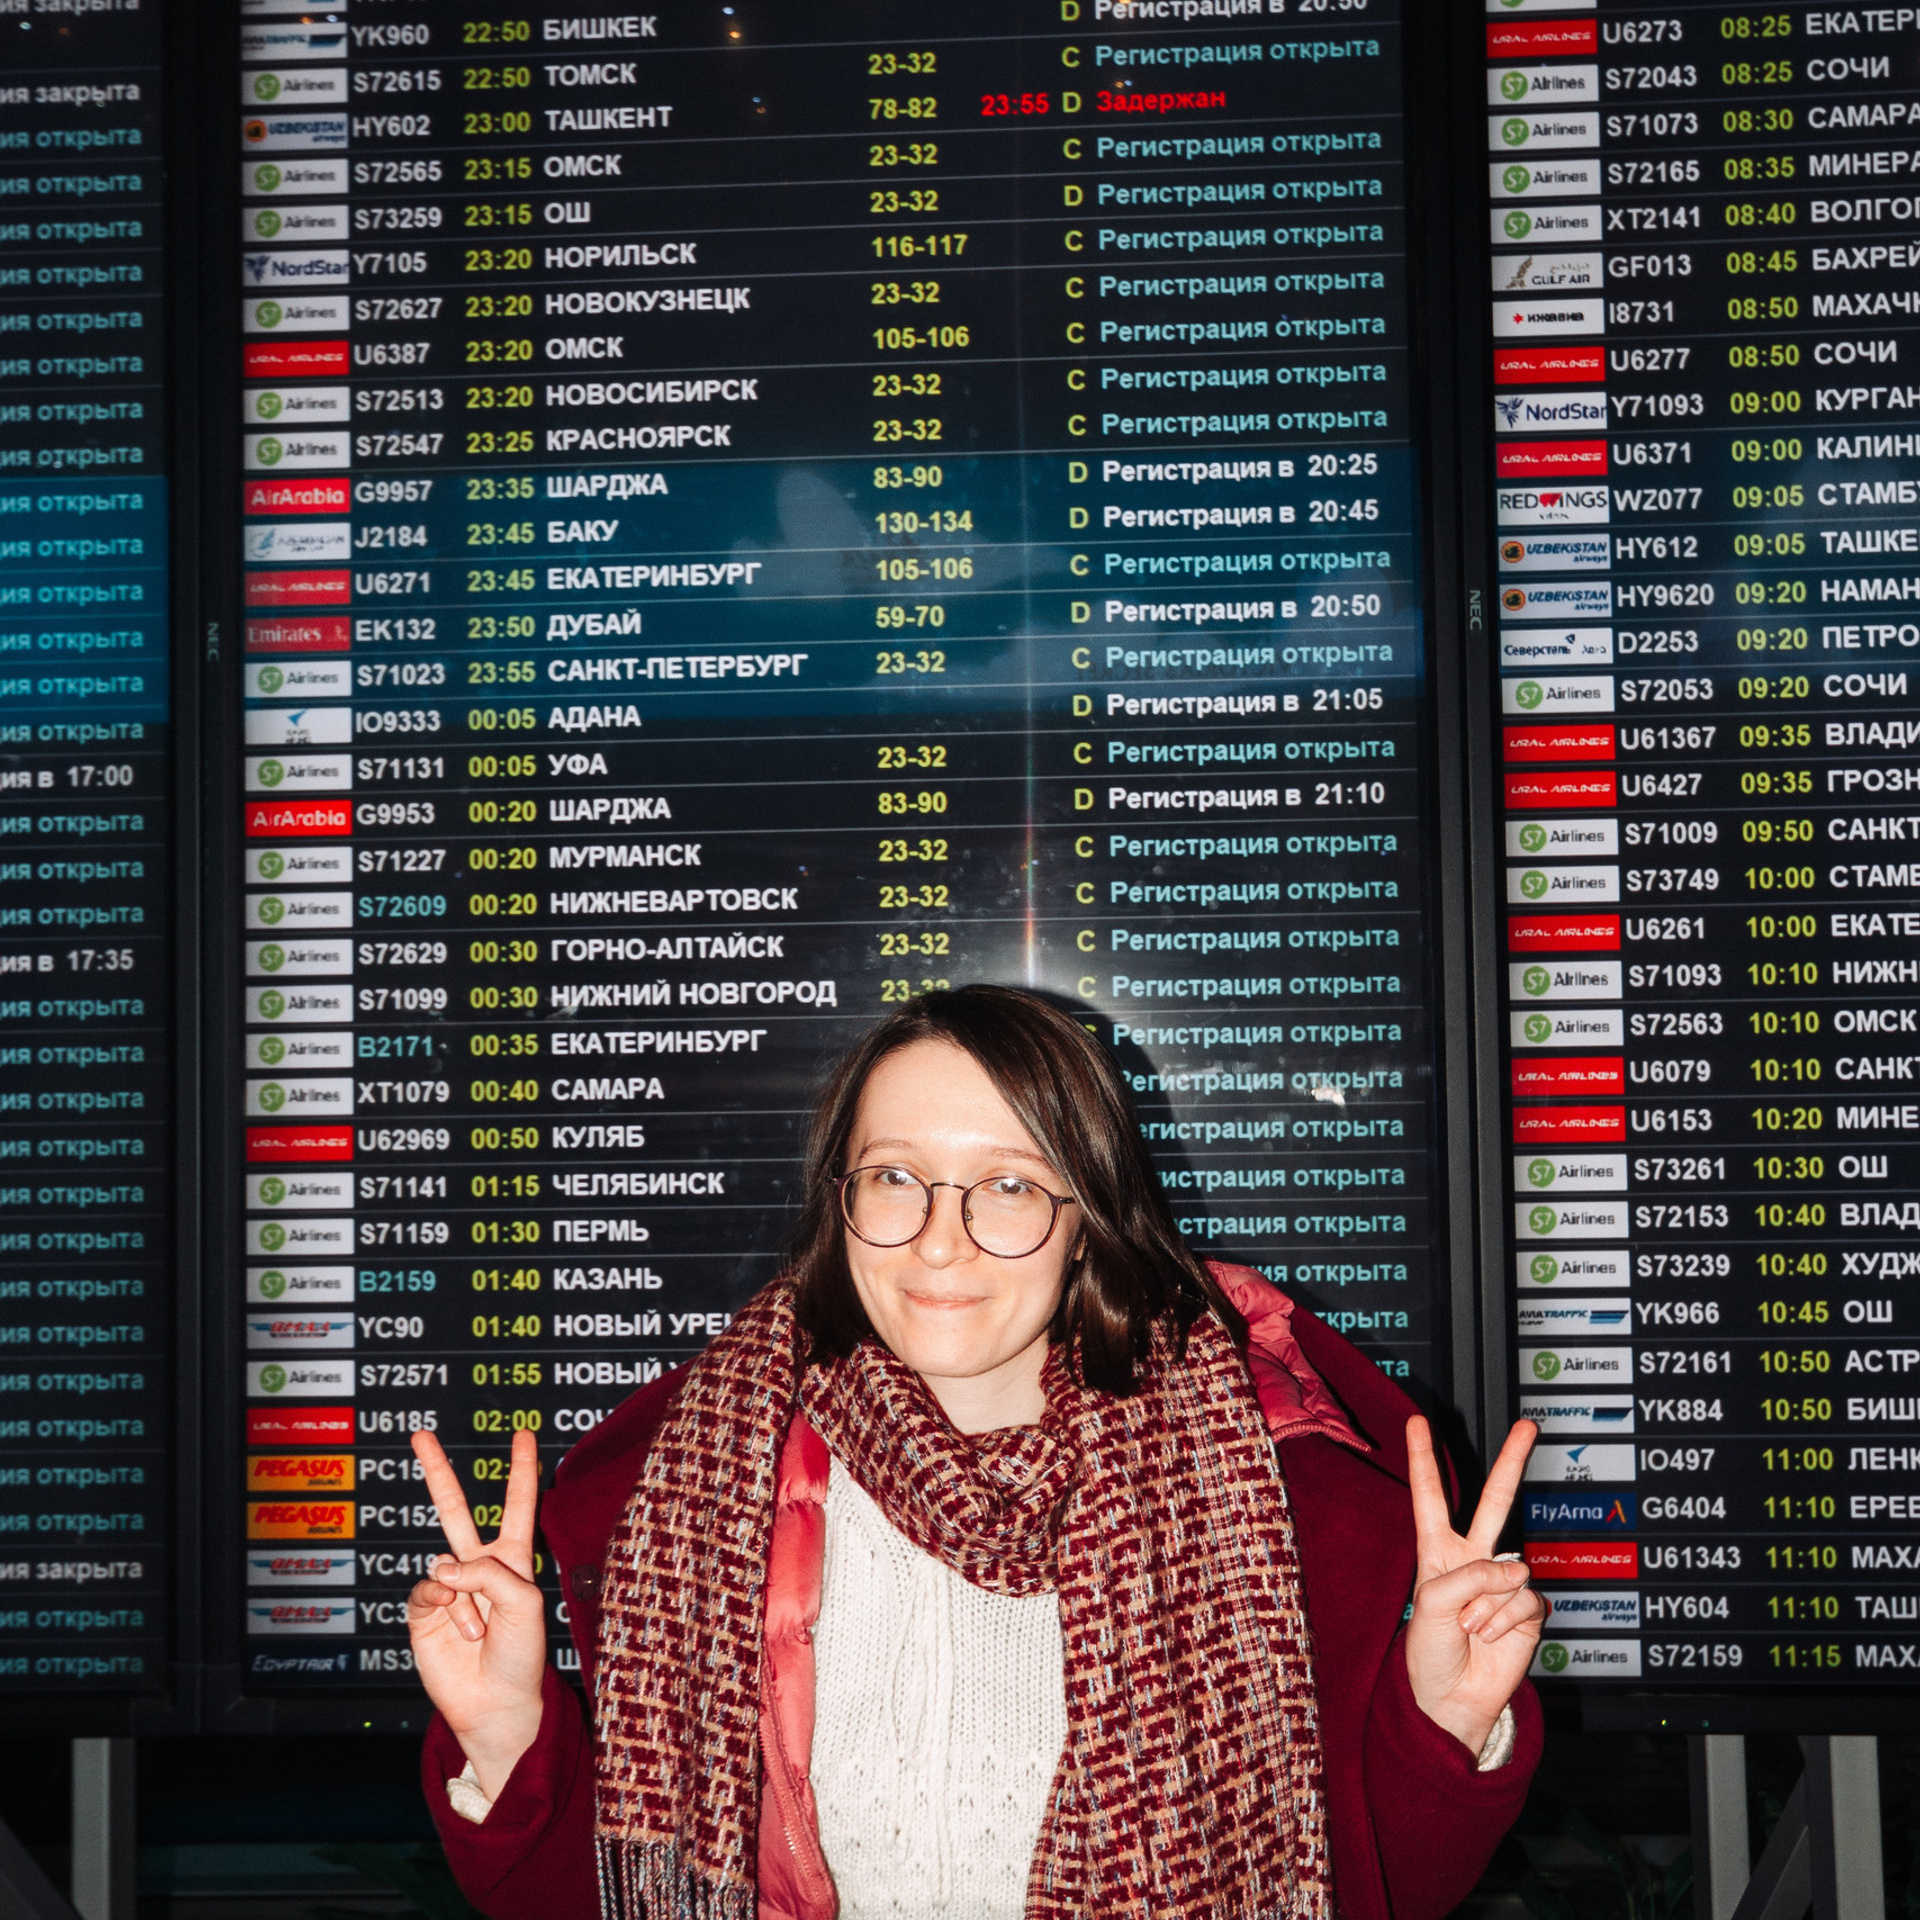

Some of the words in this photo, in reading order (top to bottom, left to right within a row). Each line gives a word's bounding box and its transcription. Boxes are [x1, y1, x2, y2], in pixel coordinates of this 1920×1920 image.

[1603, 20, 1682, 43] U6273
[1721, 15, 1791, 38] 08:25
[1806, 8, 1920, 35] ЕКАТЕР
[354, 70, 441, 92] S72615
[464, 67, 529, 89] 22:50
[544, 63, 636, 86] ТОМСК
[869, 52, 936, 74] 23-32
[1062, 47, 1079, 67] C
[1096, 45, 1262, 67] Регистрация
[1270, 40, 1379, 62] открыта
[1606, 65, 1697, 89] S72043
[1722, 61, 1792, 84] 08:25
[1807, 56, 1889, 80] СОЧИ
[36, 85, 139, 106] закрыта
[353, 115, 430, 137] HY602
[465, 112, 530, 133] 23:00
[544, 106, 673, 130] ТАШКЕНТ
[869, 97, 936, 119] 78-82
[981, 93, 1049, 116] 23:55
[1063, 92, 1081, 112] D
[1097, 91, 1225, 114] Задержан
[1607, 113, 1698, 136] S71073
[1723, 109, 1793, 132] 08:30
[36, 129, 141, 150] открыта
[353, 252, 426, 274] Y7105
[466, 249, 531, 271] 23:20
[545, 243, 696, 268] НОРИЛЬСК
[872, 233, 968, 257] 116-117
[1065, 231, 1083, 251] C
[1099, 229, 1266, 252] Регистрация
[1274, 225, 1383, 247] открыта
[272, 260, 348, 276] NordStar
[1611, 348, 1690, 371] U6277
[1729, 345, 1799, 367] 08:50
[1814, 340, 1897, 364] СОЧИ
[356, 389, 443, 411] S72513
[467, 386, 533, 408] 23:20
[547, 379, 757, 406] НОВОСИБИРСК
[873, 374, 941, 396] 23-32
[1068, 370, 1085, 390] C
[1102, 368, 1268, 391] Регистрация
[1277, 365, 1386, 387] открыта
[38, 403, 143, 424] открыта
[1526, 403, 1607, 421] NordStar
[354, 480, 432, 503] G9957
[467, 478, 533, 499] 23:35
[547, 473, 668, 500] ШАРДЖА
[874, 466, 942, 488] 83-90
[1069, 462, 1087, 482] D
[1103, 461, 1271, 484] Регистрация
[1278, 461, 1294, 477] в
[1308, 453, 1377, 476] 20:25
[251, 487, 345, 505] AirArabia
[1613, 488, 1702, 511] WZ077
[1733, 485, 1803, 507] 09:05
[1528, 590, 1608, 603] UZBEKISTAN
[1617, 584, 1714, 607] HY9620
[1736, 581, 1806, 604] 09:20
[356, 618, 435, 641] EK132
[468, 616, 534, 638] 23:50
[547, 609, 641, 641] ДУБАЙ
[876, 606, 944, 627] 59-70
[1072, 602, 1089, 623] D
[1106, 601, 1273, 624] Регистрация
[1282, 601, 1297, 617] в
[1311, 594, 1380, 617] 20:50
[1469, 590, 1482, 631] NEC
[248, 625, 322, 643] Emirates
[357, 663, 445, 686] S71023
[469, 661, 535, 683] 23:55
[548, 654, 808, 681] САНКТ-ПЕТЕРБУРГ
[877, 651, 944, 673] 23-32
[1072, 648, 1089, 668] C
[1107, 647, 1274, 670] Регистрация
[1283, 645, 1392, 667] открыта
[1621, 678, 1713, 701] S72053
[1739, 676, 1809, 698] 09:20
[1824, 673, 1907, 696] СОЧИ
[38, 771, 53, 787] в
[68, 765, 133, 786] 17:00
[1622, 773, 1702, 796] U6427
[1741, 771, 1812, 794] 09:35
[38, 815, 143, 836] открыта
[288, 857, 340, 869] Airlines
[358, 849, 446, 872] S71227
[469, 848, 536, 870] 00:20
[550, 844, 701, 868] МУРМАНСК
[359, 942, 447, 965] S72629
[470, 941, 537, 962] 00:30
[552, 932, 784, 961] ГОРНО-АЛТАЙСК
[879, 933, 949, 955] 23-32
[1077, 930, 1095, 951] C
[1112, 930, 1280, 954] Регистрация
[1288, 930, 1399, 951] открыта
[38, 955, 53, 971] в
[68, 949, 133, 970] 17:35
[359, 988, 447, 1010] S71099
[470, 986, 538, 1008] 00:30
[550, 980, 671, 1007] НИЖНИЙ
[679, 980, 837, 1007] НОВГОРОД
[1077, 977, 1096, 999] C
[1113, 976, 1281, 1000] Регистрация
[1290, 976, 1400, 998] открыта
[1631, 1013, 1723, 1035] S72563
[1750, 1011, 1819, 1033] 10:10
[1834, 1009, 1917, 1032] ОМСК
[358, 1129, 450, 1151] U62969
[471, 1128, 539, 1149] 00:50
[553, 1125, 644, 1148] КУЛЯБ
[1293, 1120, 1403, 1141] открыта
[1558, 1165, 1614, 1178] Airlines
[1635, 1158, 1724, 1180] S73261
[1754, 1157, 1823, 1179] 10:30
[1839, 1156, 1887, 1178] ОШ
[38, 1187, 143, 1207] открыта
[359, 1270, 436, 1292] B2159
[472, 1269, 540, 1291] 01:40
[554, 1268, 662, 1290] КАЗАНЬ
[1296, 1265, 1407, 1286] открыта
[358, 1317, 423, 1338] YC90
[473, 1315, 540, 1337] 01:40
[554, 1310, 661, 1336] НОВЫЙ
[1636, 1302, 1719, 1324] YK966
[1758, 1301, 1828, 1323] 10:45
[1843, 1300, 1892, 1322] ОШ
[360, 1411, 437, 1432] U6185
[473, 1410, 542, 1431] 02:00
[254, 1459, 347, 1478] PEGASUS
[1531, 1503, 1603, 1522] FlyArna
[1642, 1497, 1726, 1518] G6404
[1765, 1496, 1834, 1518] 11:10
[37, 1562, 142, 1583] закрыта
[36, 1657, 141, 1677] открыта
[1649, 1645, 1742, 1666] S72159
[1770, 1645, 1840, 1667] 11:15
